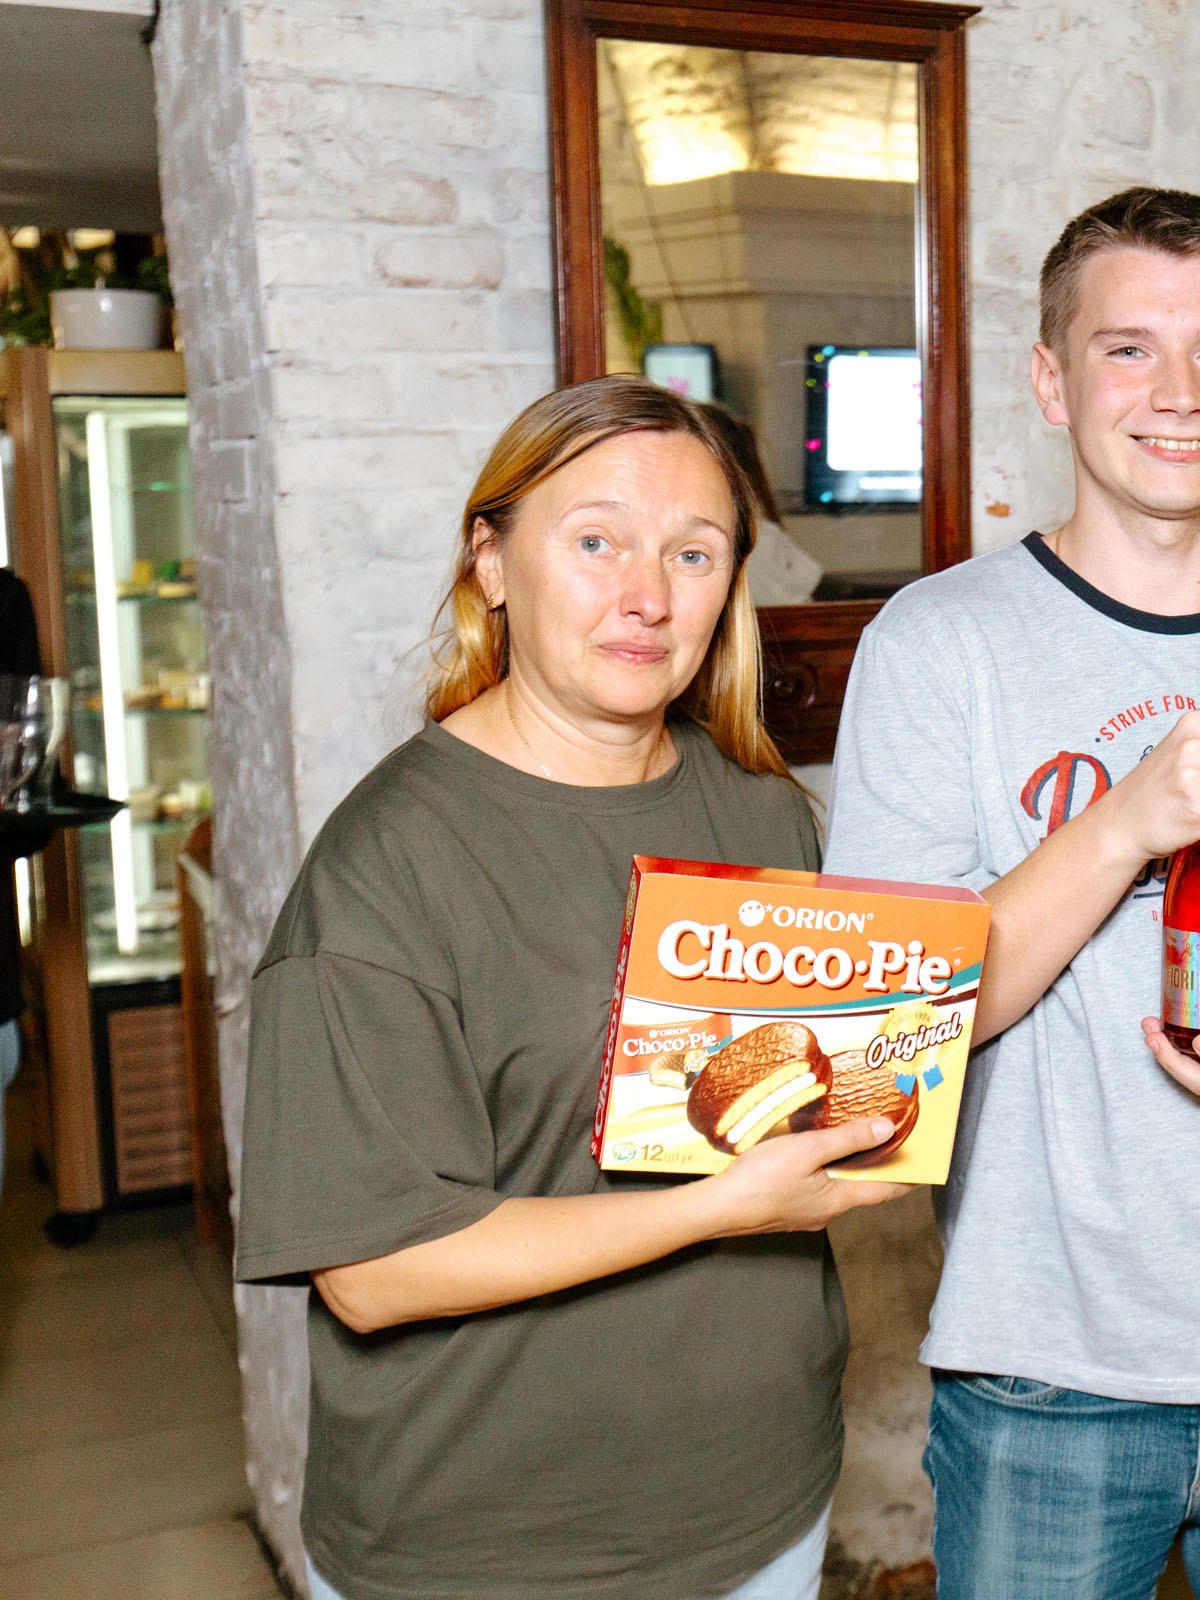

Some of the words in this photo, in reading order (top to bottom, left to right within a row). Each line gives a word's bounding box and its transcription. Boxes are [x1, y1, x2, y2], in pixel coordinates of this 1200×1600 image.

[1100, 699, 1157, 741] STRIVE
[1162, 695, 1196, 713] FOR
[772, 906, 865, 933] ORION
[866, 1011, 963, 1070] Original
[641, 1144, 664, 1161] 12
